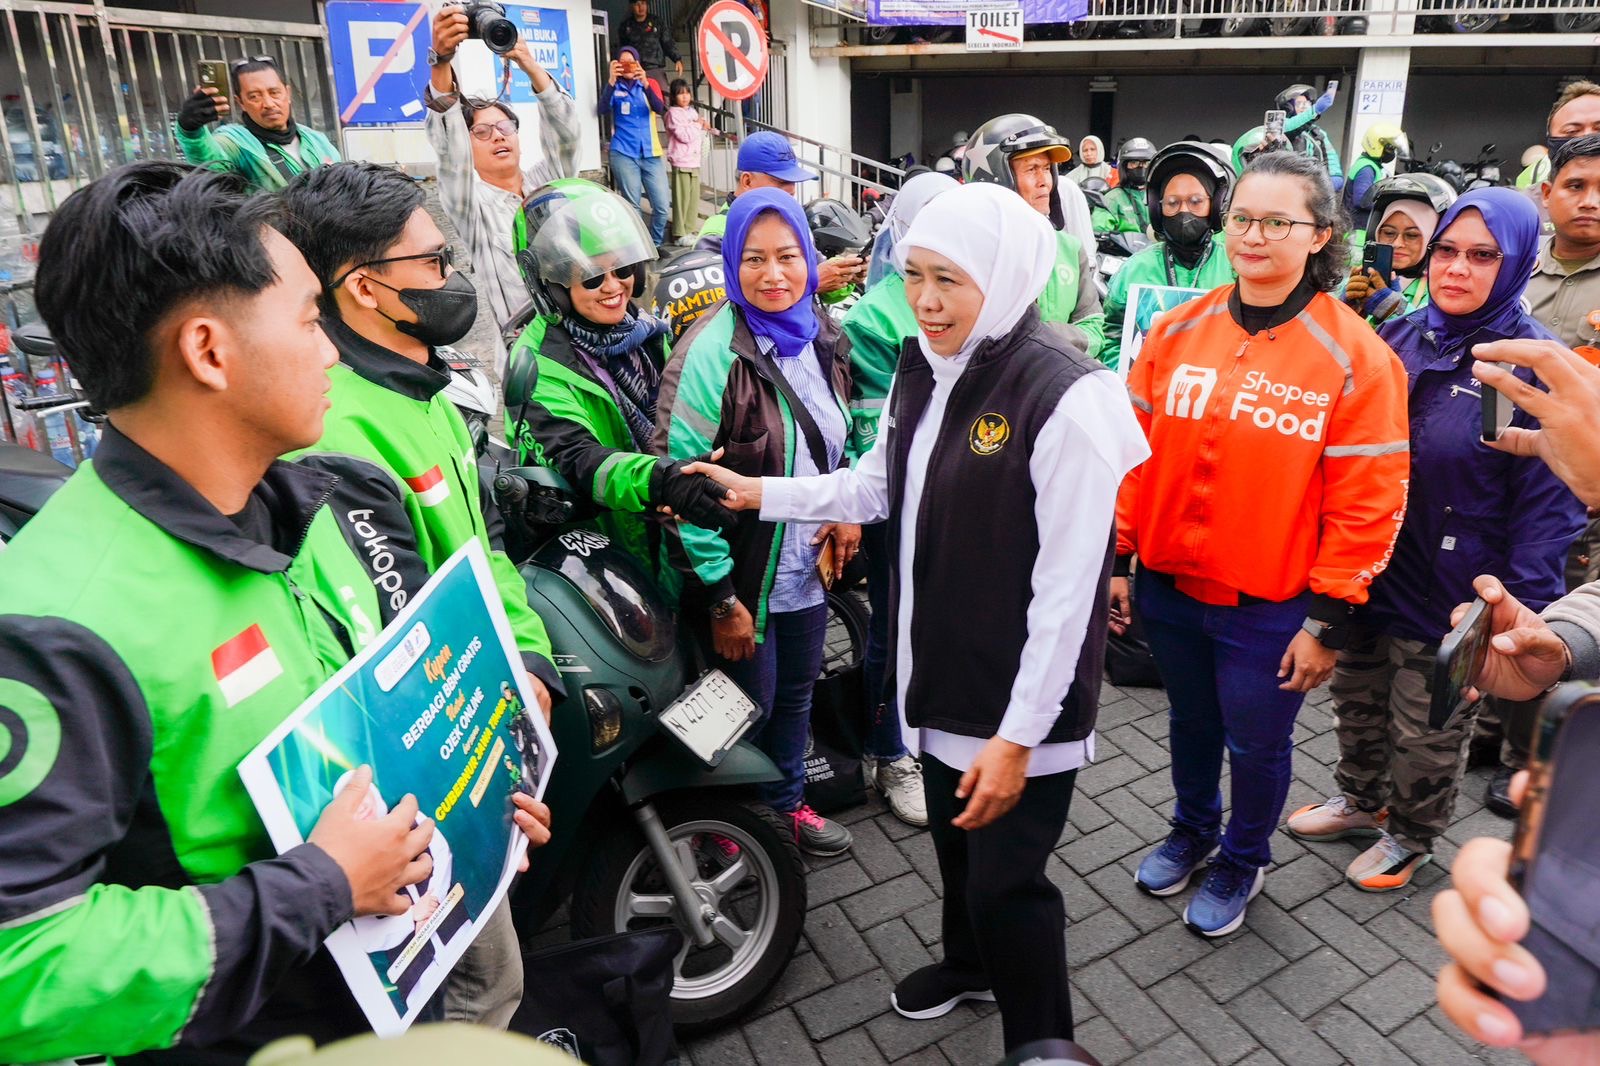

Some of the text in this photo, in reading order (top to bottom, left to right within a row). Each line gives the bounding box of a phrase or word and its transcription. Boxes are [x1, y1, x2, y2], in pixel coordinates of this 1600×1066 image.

[517, 27, 558, 41] AMI BUKA
[969, 12, 1020, 28] TOILET
[348, 21, 415, 104] P
[720, 21, 750, 82] P
[1362, 94, 1378, 102] R2
[1363, 81, 1403, 89] PARKIR
[1241, 370, 1330, 406] Shopee
[1229, 391, 1326, 442] Food
[347, 508, 408, 611] tokope
[401, 691, 446, 750] BERBAGI
[441, 667, 461, 699] BBM
[457, 635, 483, 675] GRATIS
[667, 717, 688, 736] N
[681, 692, 713, 724] 4277
[439, 686, 485, 760] OJEK ONLINE
[435, 755, 479, 822] GUBERNUR
[474, 727, 494, 761] JAWA
